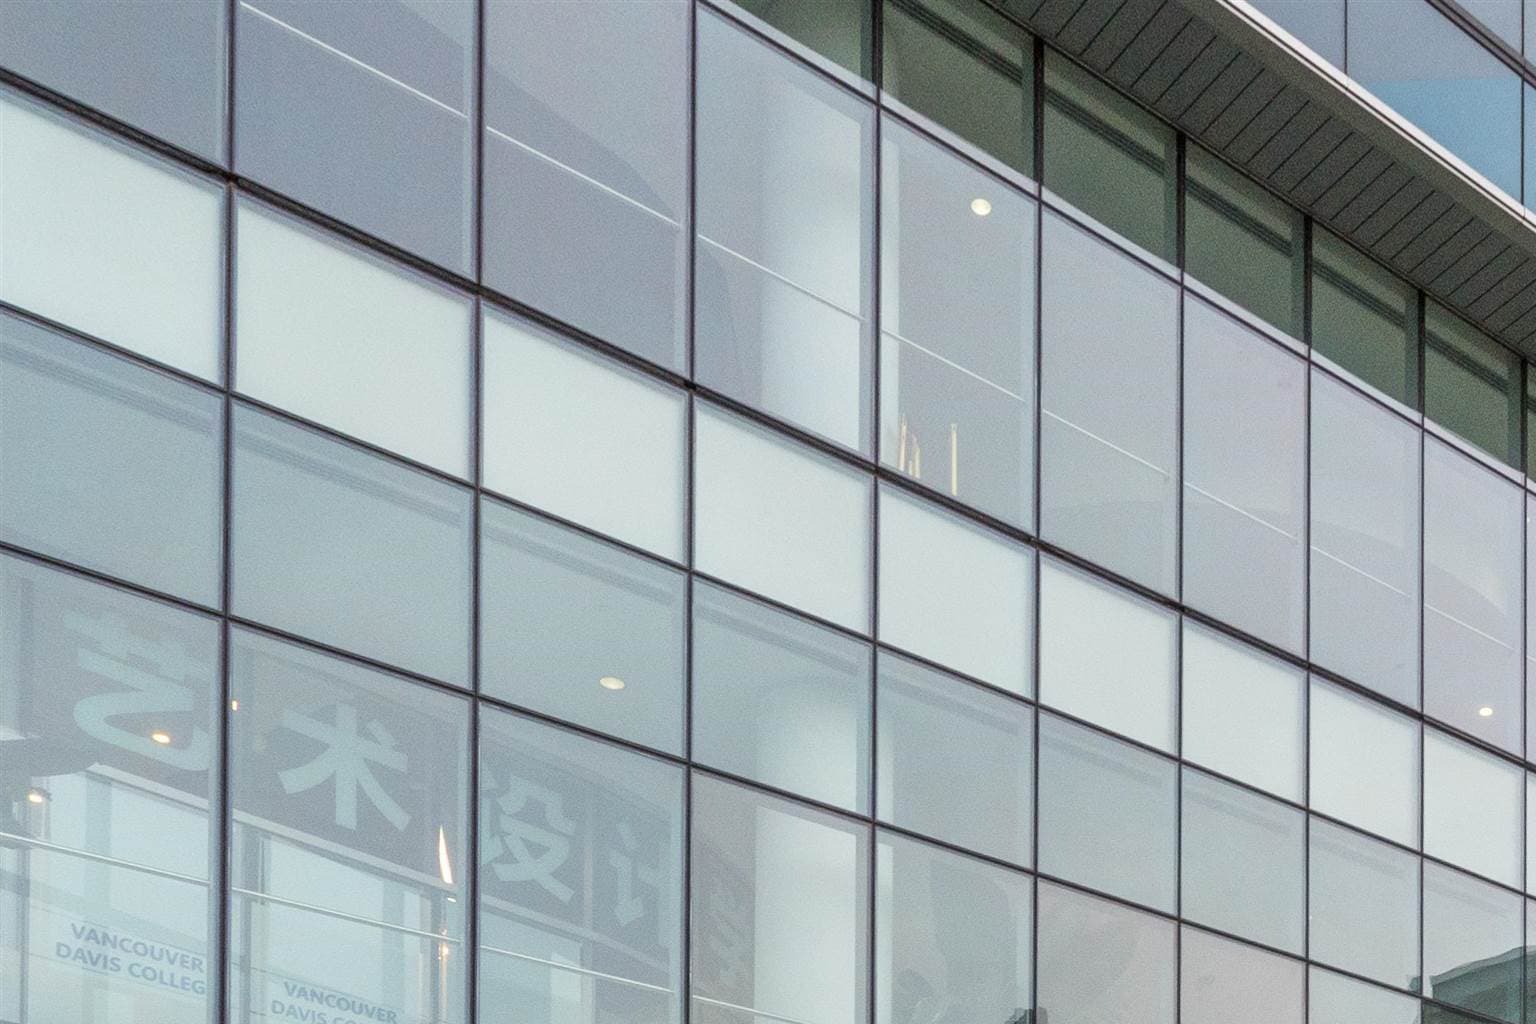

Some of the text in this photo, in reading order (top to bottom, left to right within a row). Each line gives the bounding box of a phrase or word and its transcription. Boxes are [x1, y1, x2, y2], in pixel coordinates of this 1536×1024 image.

[55, 941, 206, 996] DAVIS COLLEG
[70, 922, 204, 973] VANCOUVER
[283, 980, 397, 1024] VANCOUVER
